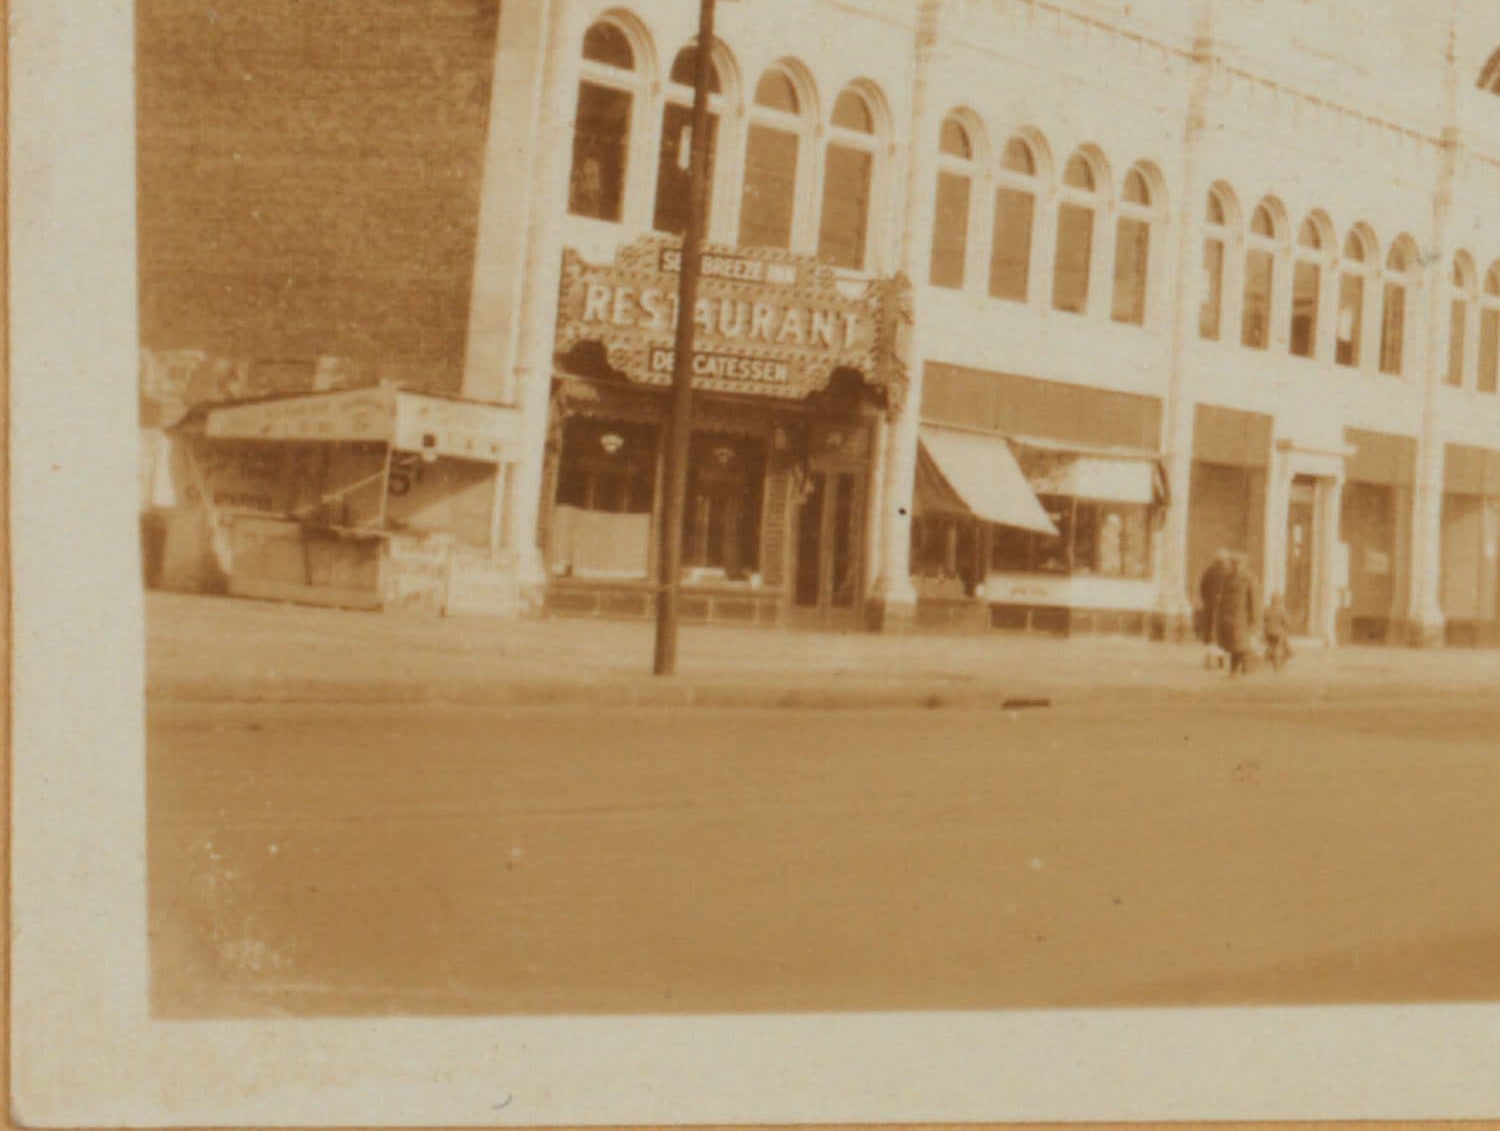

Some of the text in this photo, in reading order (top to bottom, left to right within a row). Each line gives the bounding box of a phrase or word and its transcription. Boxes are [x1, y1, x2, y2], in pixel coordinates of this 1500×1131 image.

[701, 255, 764, 281] BREEZE
[582, 284, 860, 348] RESTAURANT
[652, 350, 789, 382] DECATESSEN
